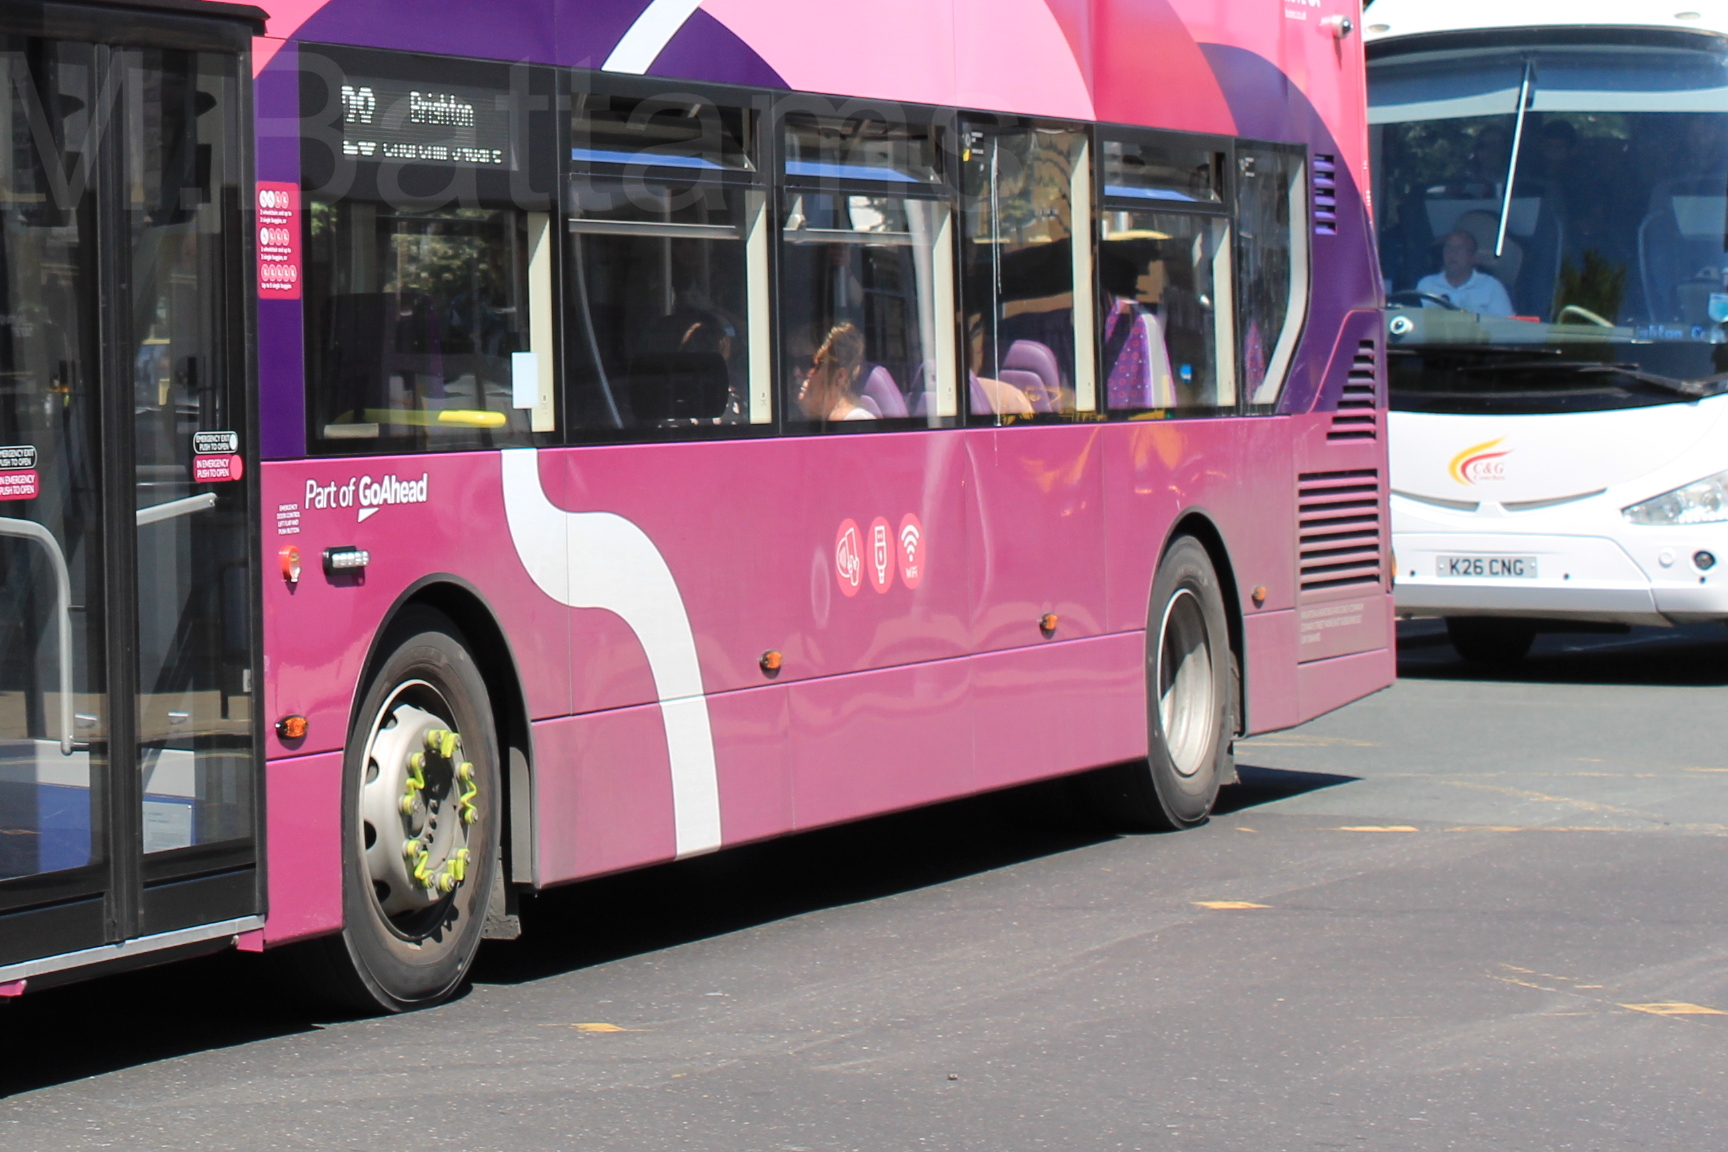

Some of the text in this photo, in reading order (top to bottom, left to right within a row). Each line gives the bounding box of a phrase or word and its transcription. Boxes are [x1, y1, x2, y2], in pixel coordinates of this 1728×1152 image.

[410, 91, 474, 127] Brighton
[1472, 462, 1505, 474] C&G
[305, 473, 428, 509] Part of GoAhead
[1449, 557, 1524, 577] K26 CNG
